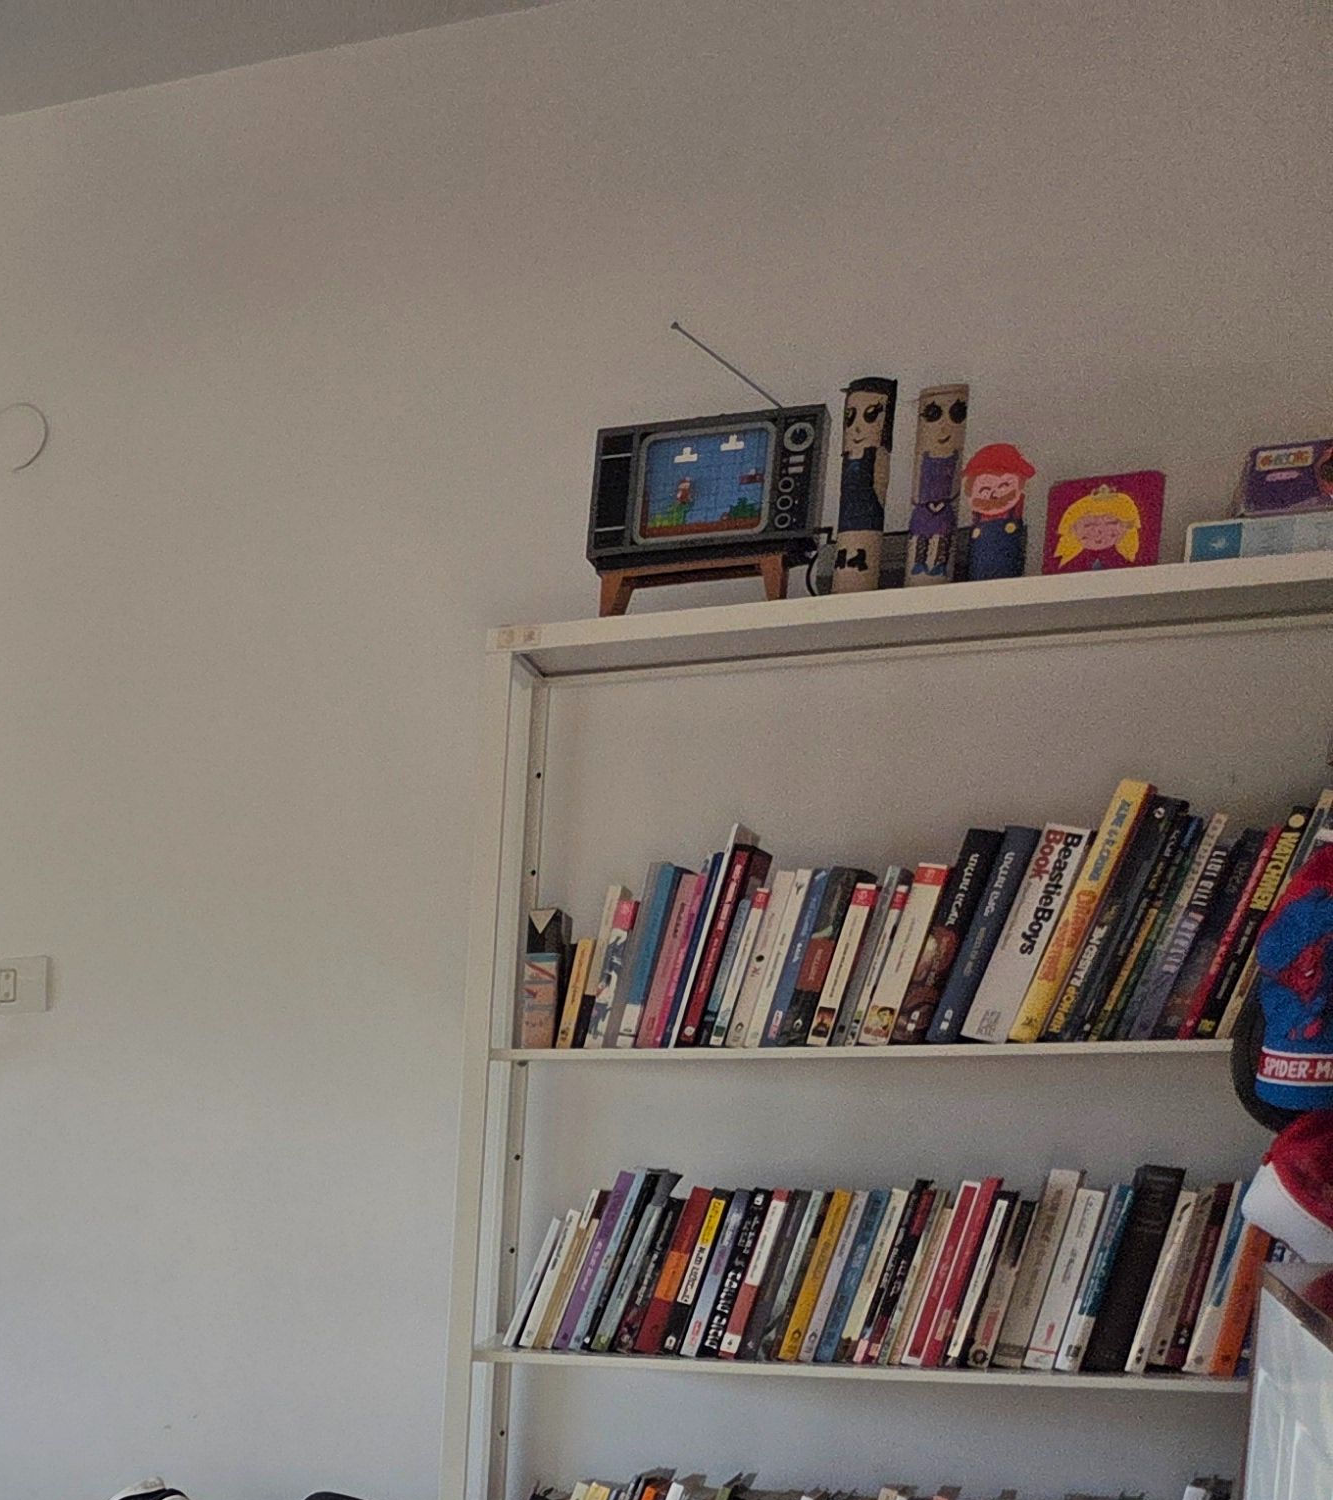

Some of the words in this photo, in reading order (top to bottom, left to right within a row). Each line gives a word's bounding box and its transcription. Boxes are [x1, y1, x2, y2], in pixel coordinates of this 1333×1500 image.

[959, 853, 980, 892] תולדות
[993, 851, 1015, 889] תולדות
[1029, 829, 1065, 881] Book
[1250, 831, 1301, 911] WATCHMEN
[1048, 1012, 1065, 1033] HIP
[1058, 986, 1076, 1013] HOP
[1070, 944, 1097, 987] RAISED
[1262, 1056, 1333, 1079] SPIDER-M
